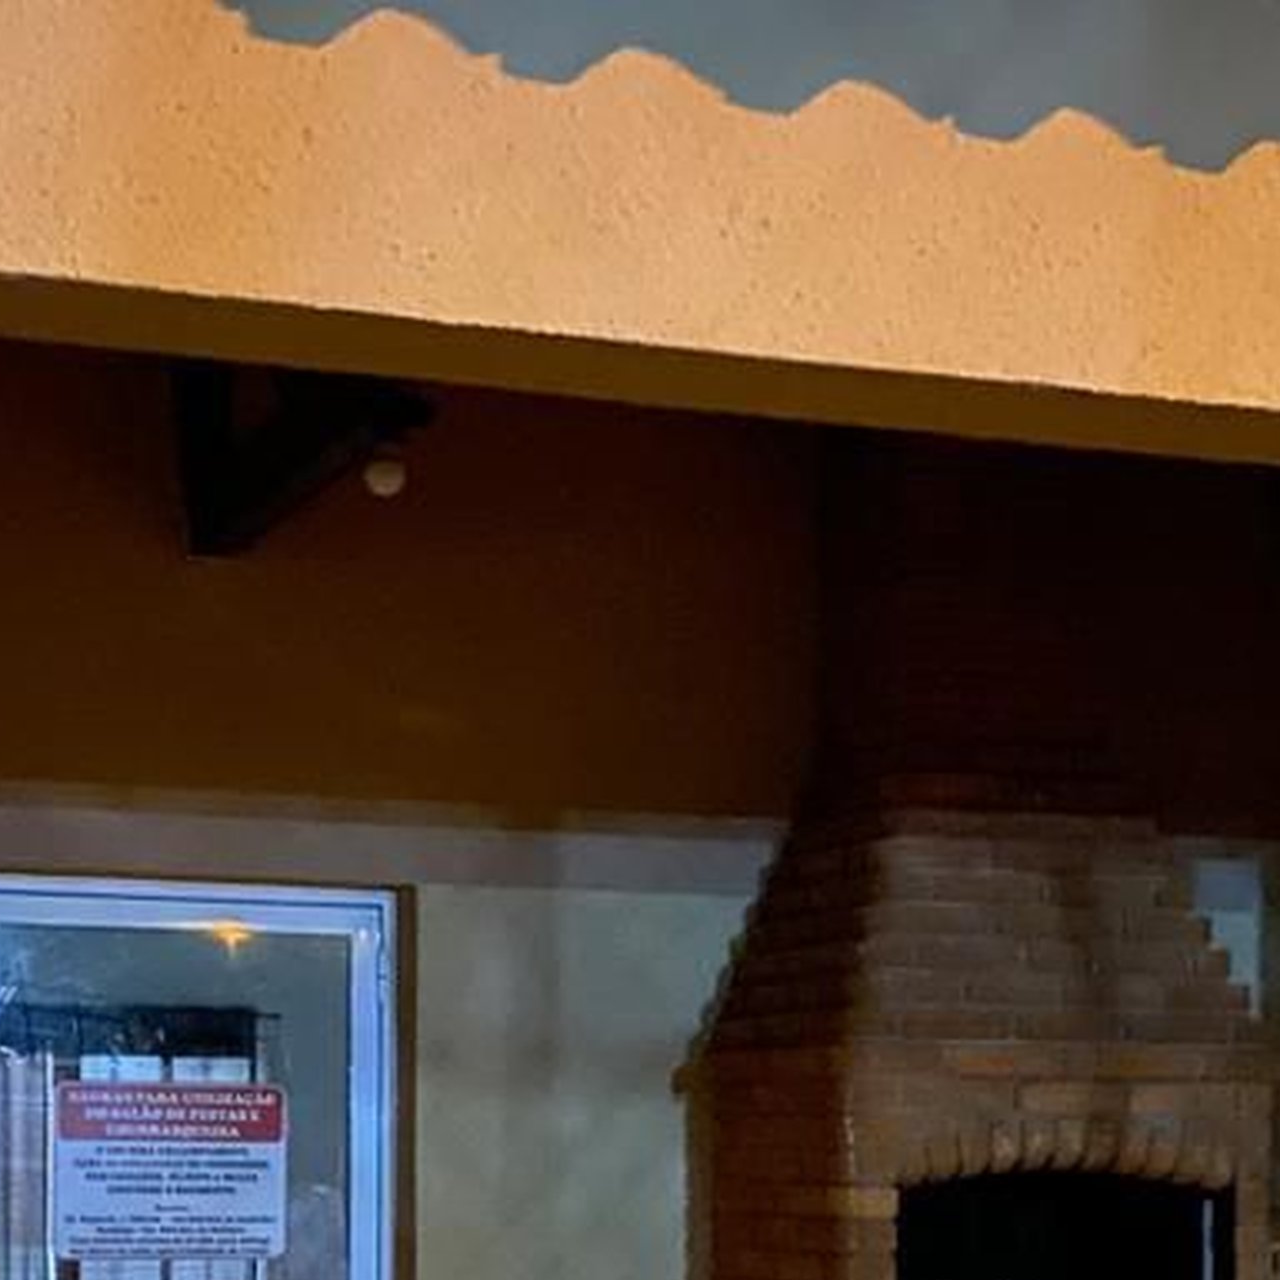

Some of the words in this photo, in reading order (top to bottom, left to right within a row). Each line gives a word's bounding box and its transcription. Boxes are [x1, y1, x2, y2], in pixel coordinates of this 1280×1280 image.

[136, 1091, 179, 1105] PARA
[182, 1091, 276, 1106] UTILIZAÇÃO
[111, 1104, 163, 1121] SALÃO
[166, 1107, 185, 1121] DE
[189, 1107, 248, 1121] FESTAS
